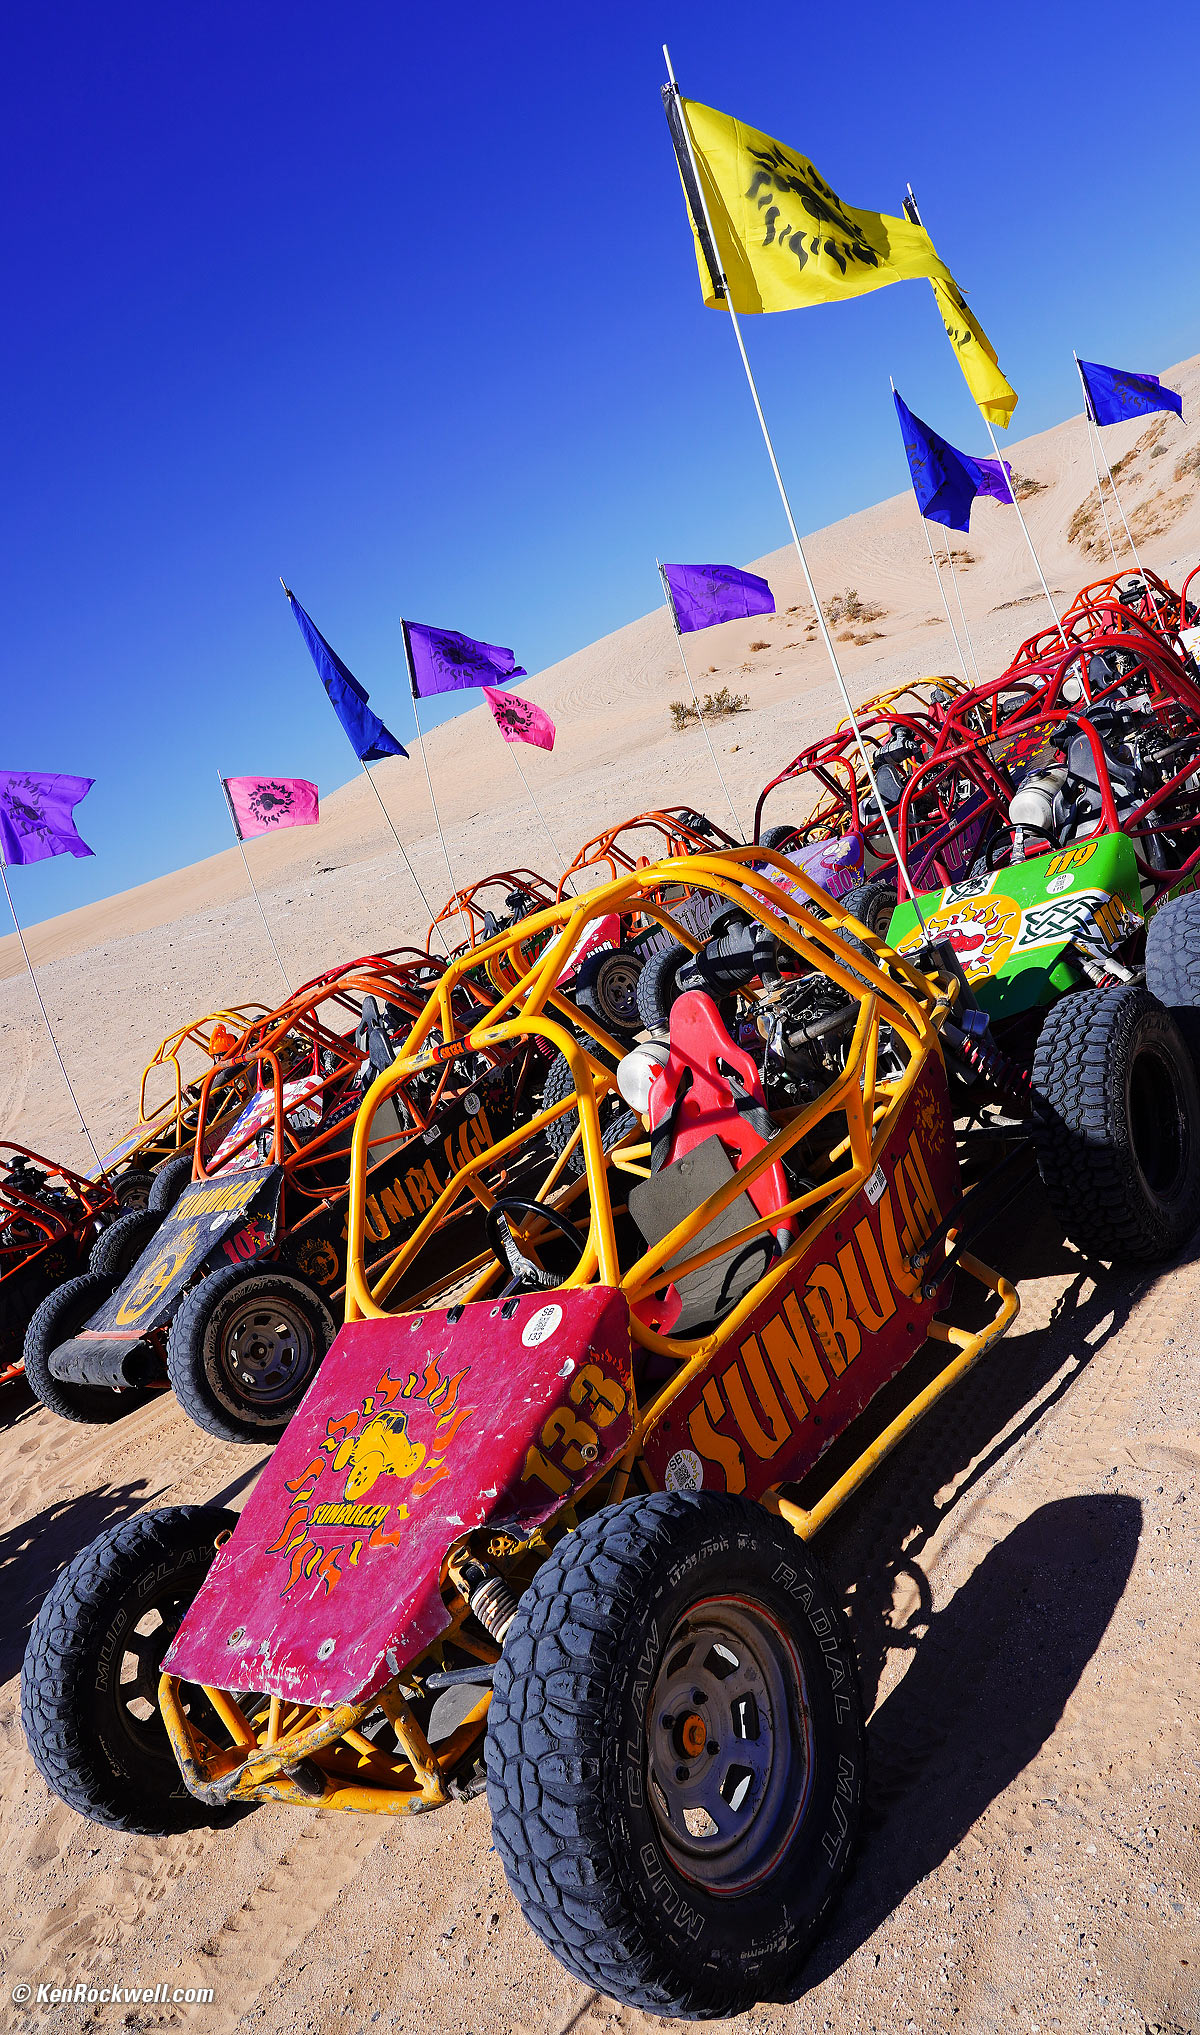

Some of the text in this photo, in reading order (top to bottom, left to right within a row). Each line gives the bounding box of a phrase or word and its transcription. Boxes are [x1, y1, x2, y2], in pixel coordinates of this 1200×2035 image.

[976, 733, 997, 747] SB119
[1043, 841, 1099, 878] 119
[825, 867, 855, 899] 110
[541, 1307, 555, 1317] SB
[687, 1128, 943, 1496] SUNBUGGY
[521, 1364, 626, 1495] 133
[669, 1452, 683, 1471] SB
[306, 1503, 391, 1528] SUNBUGGY
[94, 1608, 128, 1692] MUD
[627, 1560, 855, 1942] MUD CLAW RADIAL M/T
